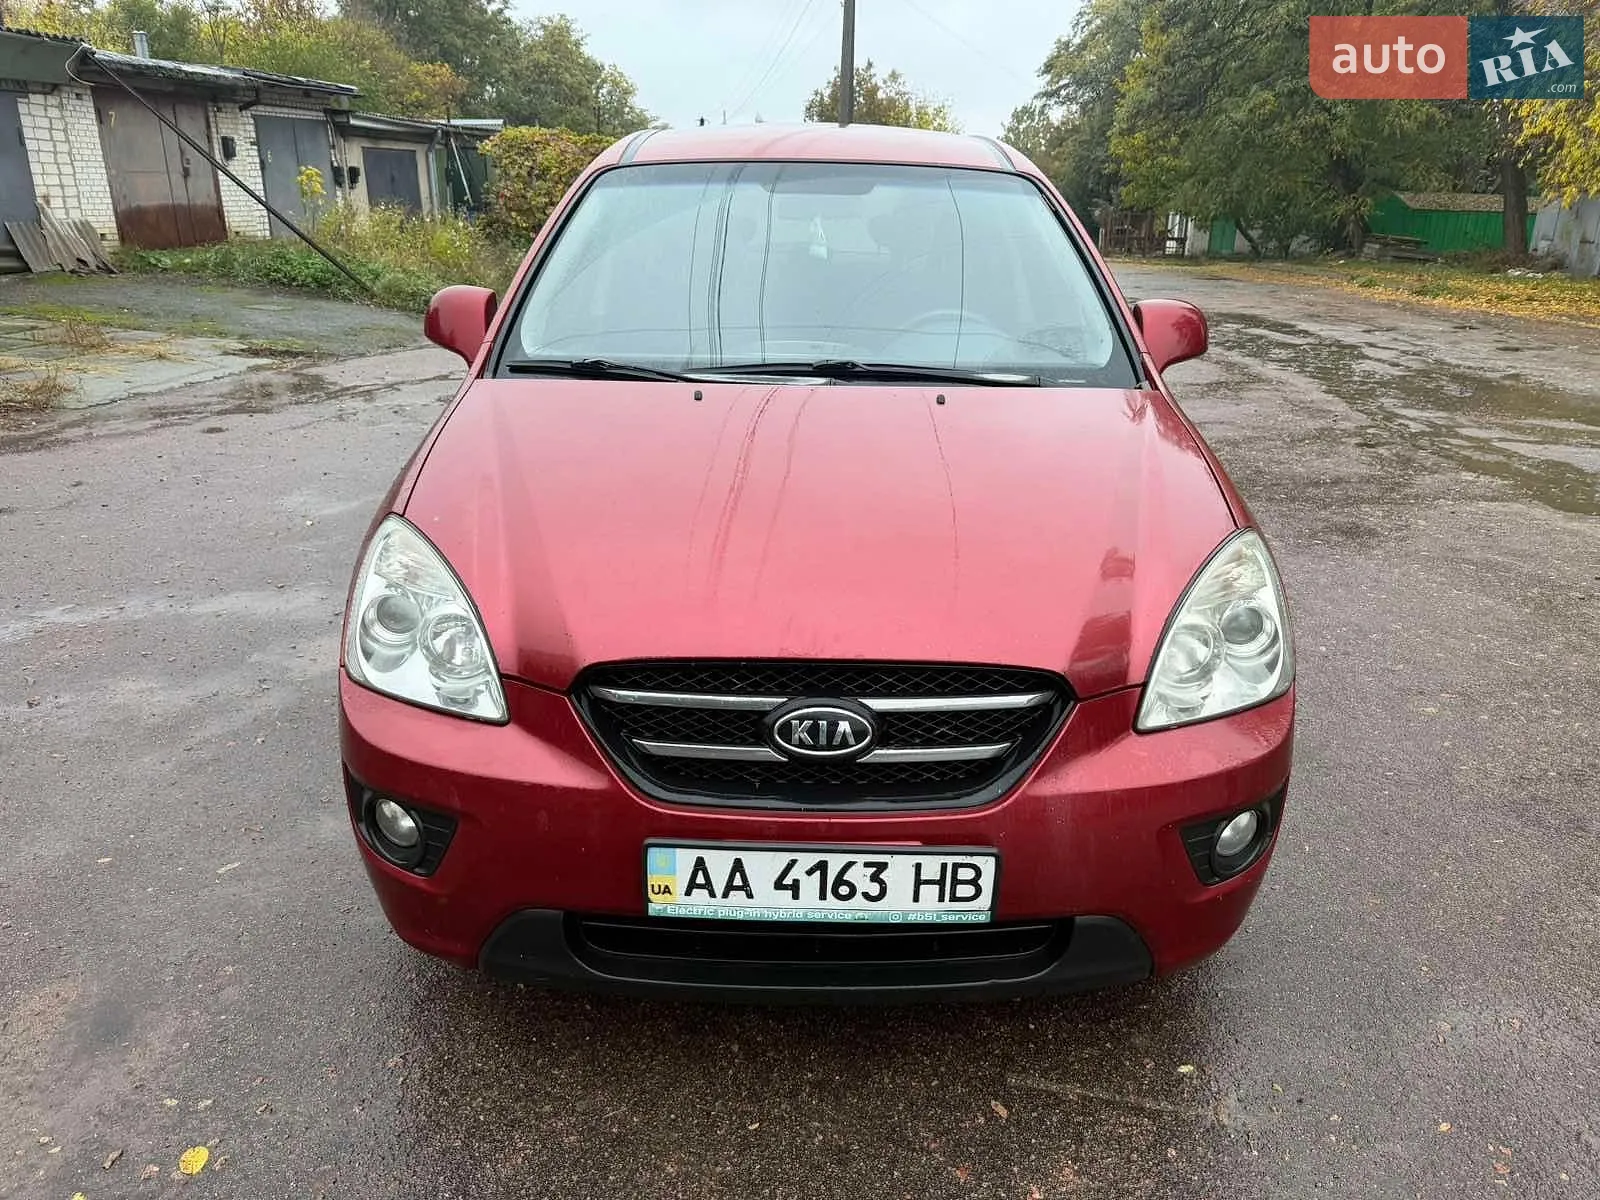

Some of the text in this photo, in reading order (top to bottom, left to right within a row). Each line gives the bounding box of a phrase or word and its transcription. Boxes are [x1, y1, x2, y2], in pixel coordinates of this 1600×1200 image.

[790, 720, 856, 745] KIA
[651, 884, 672, 895] UA
[684, 856, 982, 903] AA 4163 HB
[667, 904, 852, 920] Electric plug-in hybrid service
